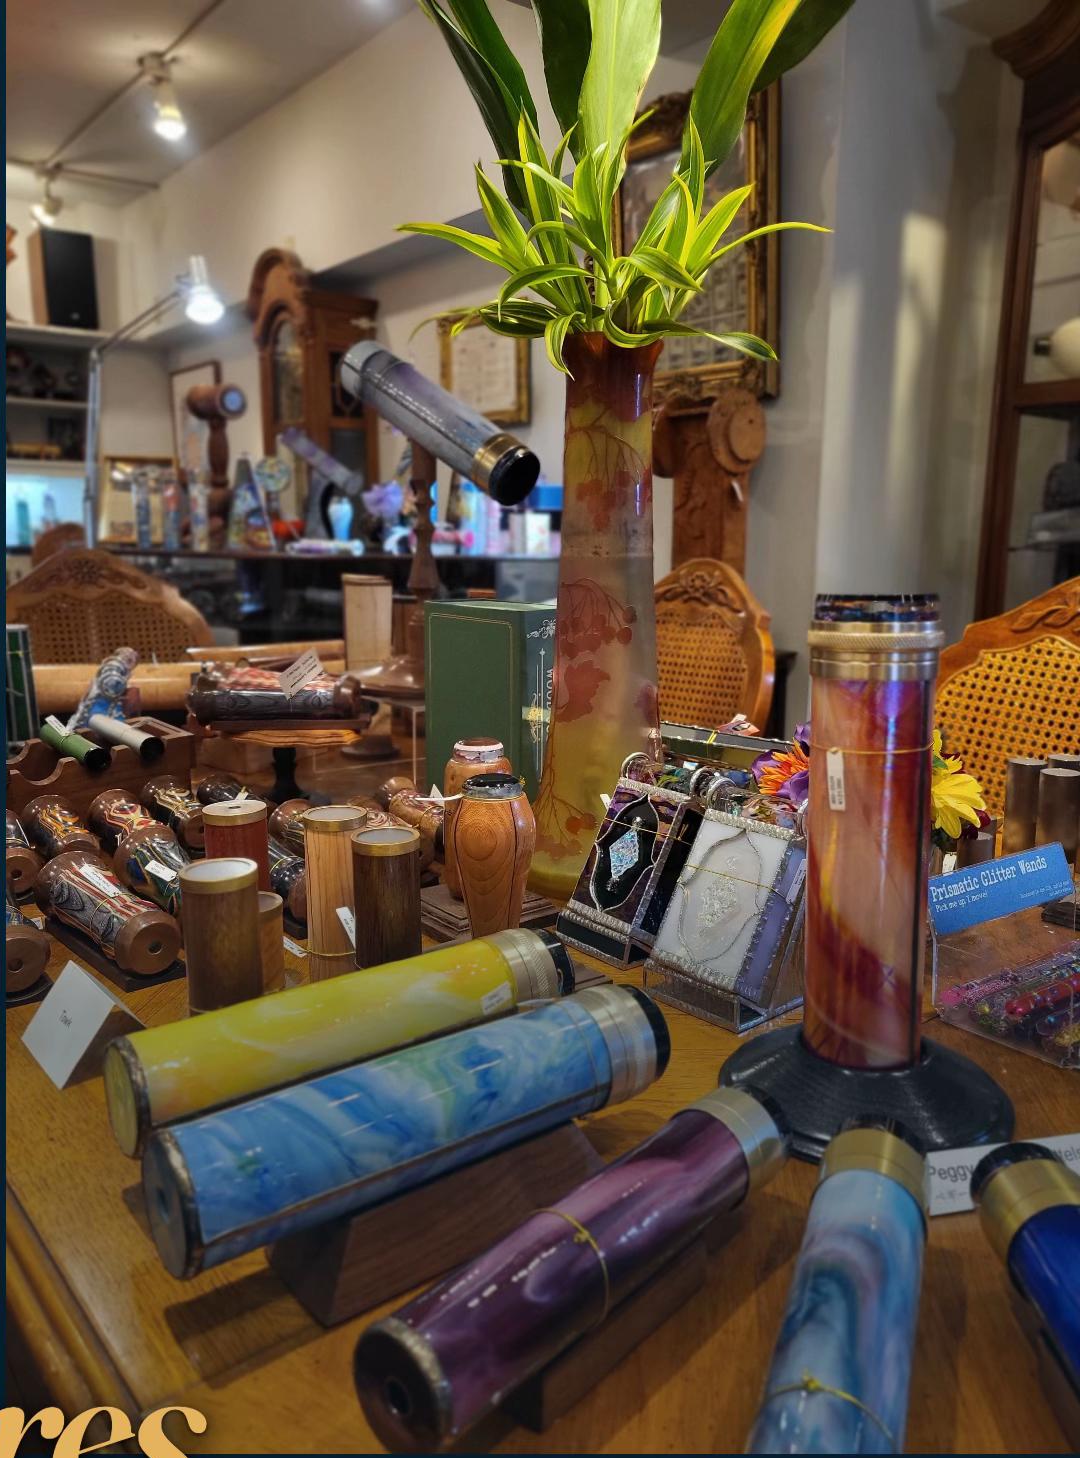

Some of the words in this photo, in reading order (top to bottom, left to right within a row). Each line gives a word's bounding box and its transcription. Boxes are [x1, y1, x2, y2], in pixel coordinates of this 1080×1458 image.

[929, 876, 980, 902] Prismatic
[980, 866, 1016, 886] Glitter
[1017, 855, 1048, 876] Wands
